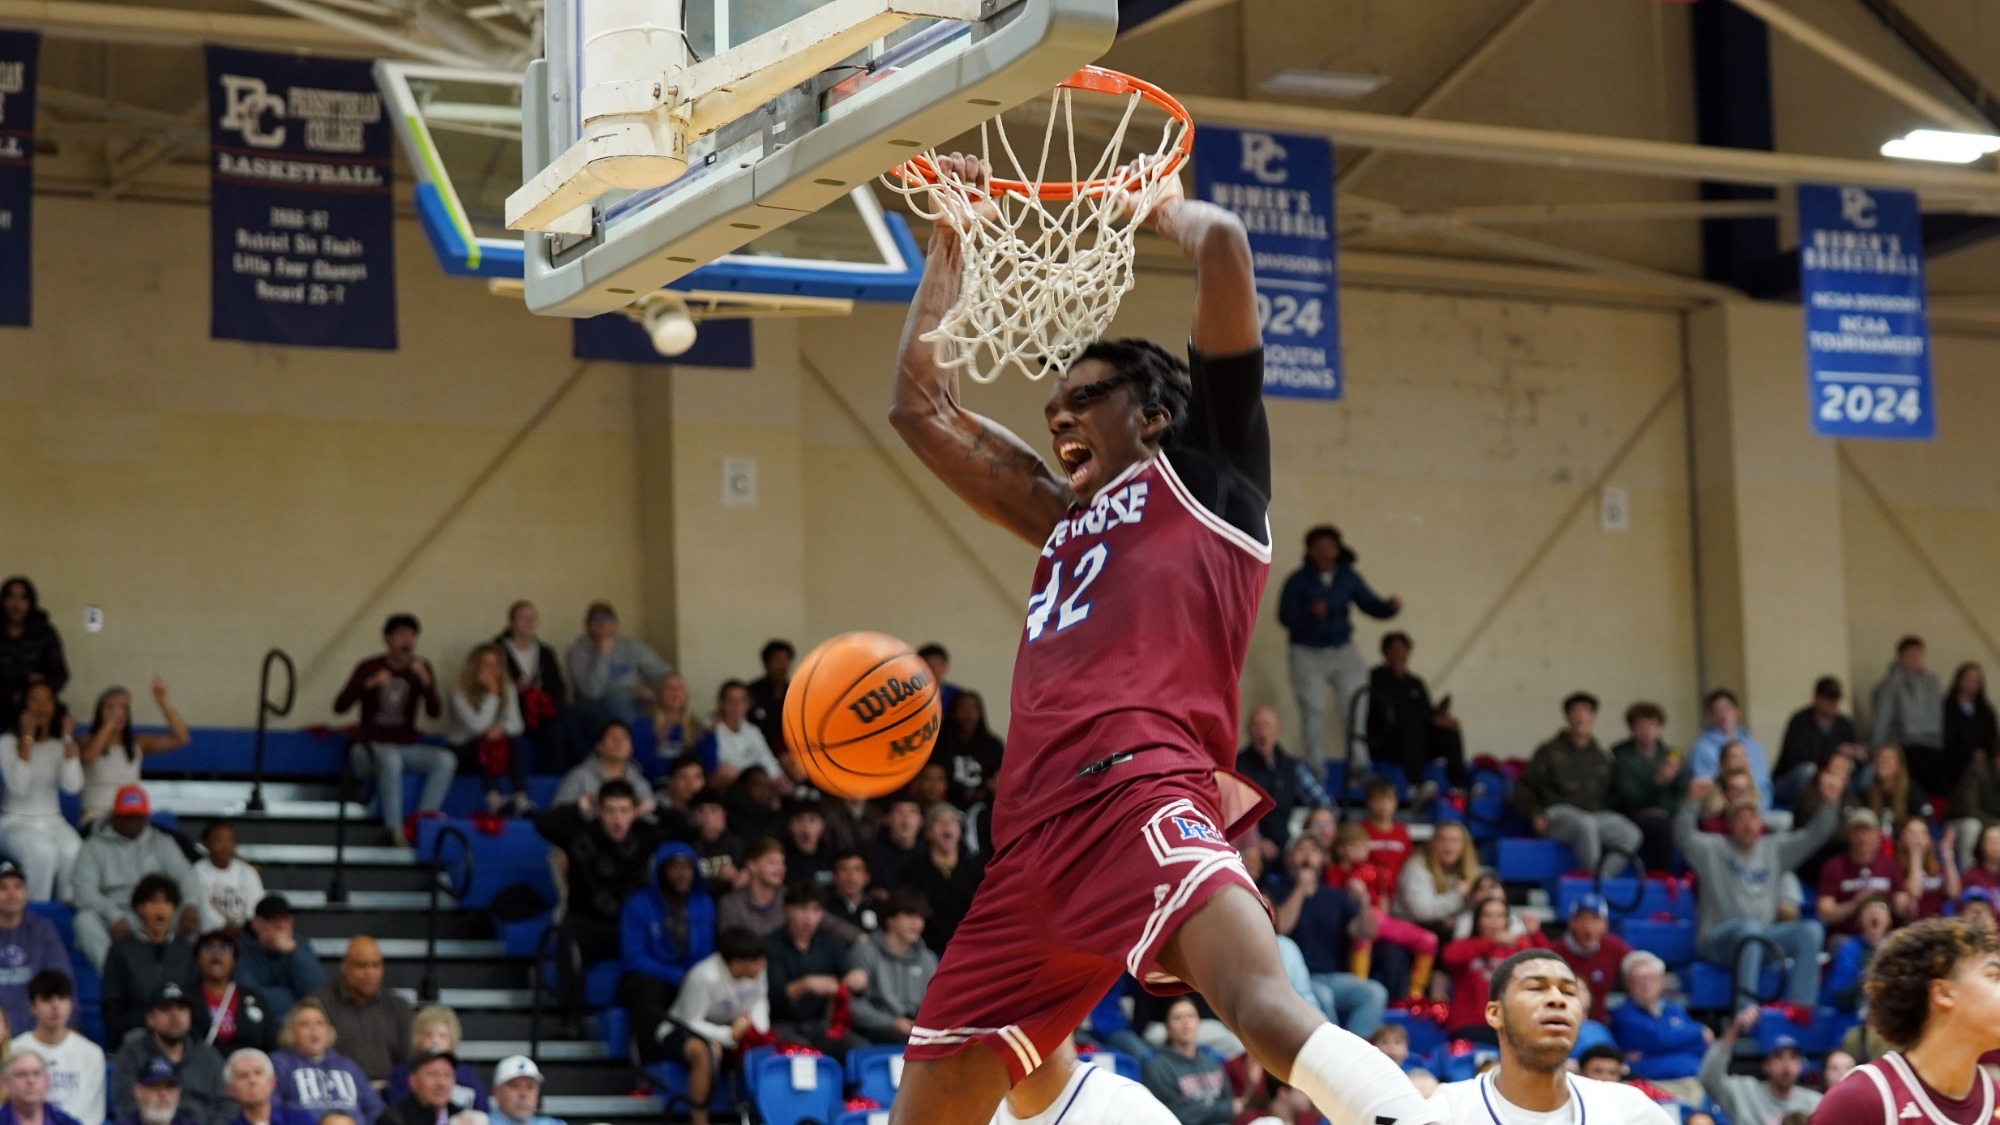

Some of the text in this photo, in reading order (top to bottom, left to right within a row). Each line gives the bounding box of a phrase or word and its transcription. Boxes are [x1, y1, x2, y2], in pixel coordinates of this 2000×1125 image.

[220, 73, 286, 147] PC
[304, 119, 364, 152] COLLEGE
[219, 153, 382, 186] BASKETBALL
[1240, 132, 1288, 183] PC
[1211, 184, 1311, 212] WOMEN'S
[1810, 331, 1923, 357] TOURNAMENT
[1839, 314, 1891, 337] NCAA
[1818, 383, 1922, 425] 2024
[1026, 541, 1109, 642] 42
[848, 671, 929, 724] Wilson
